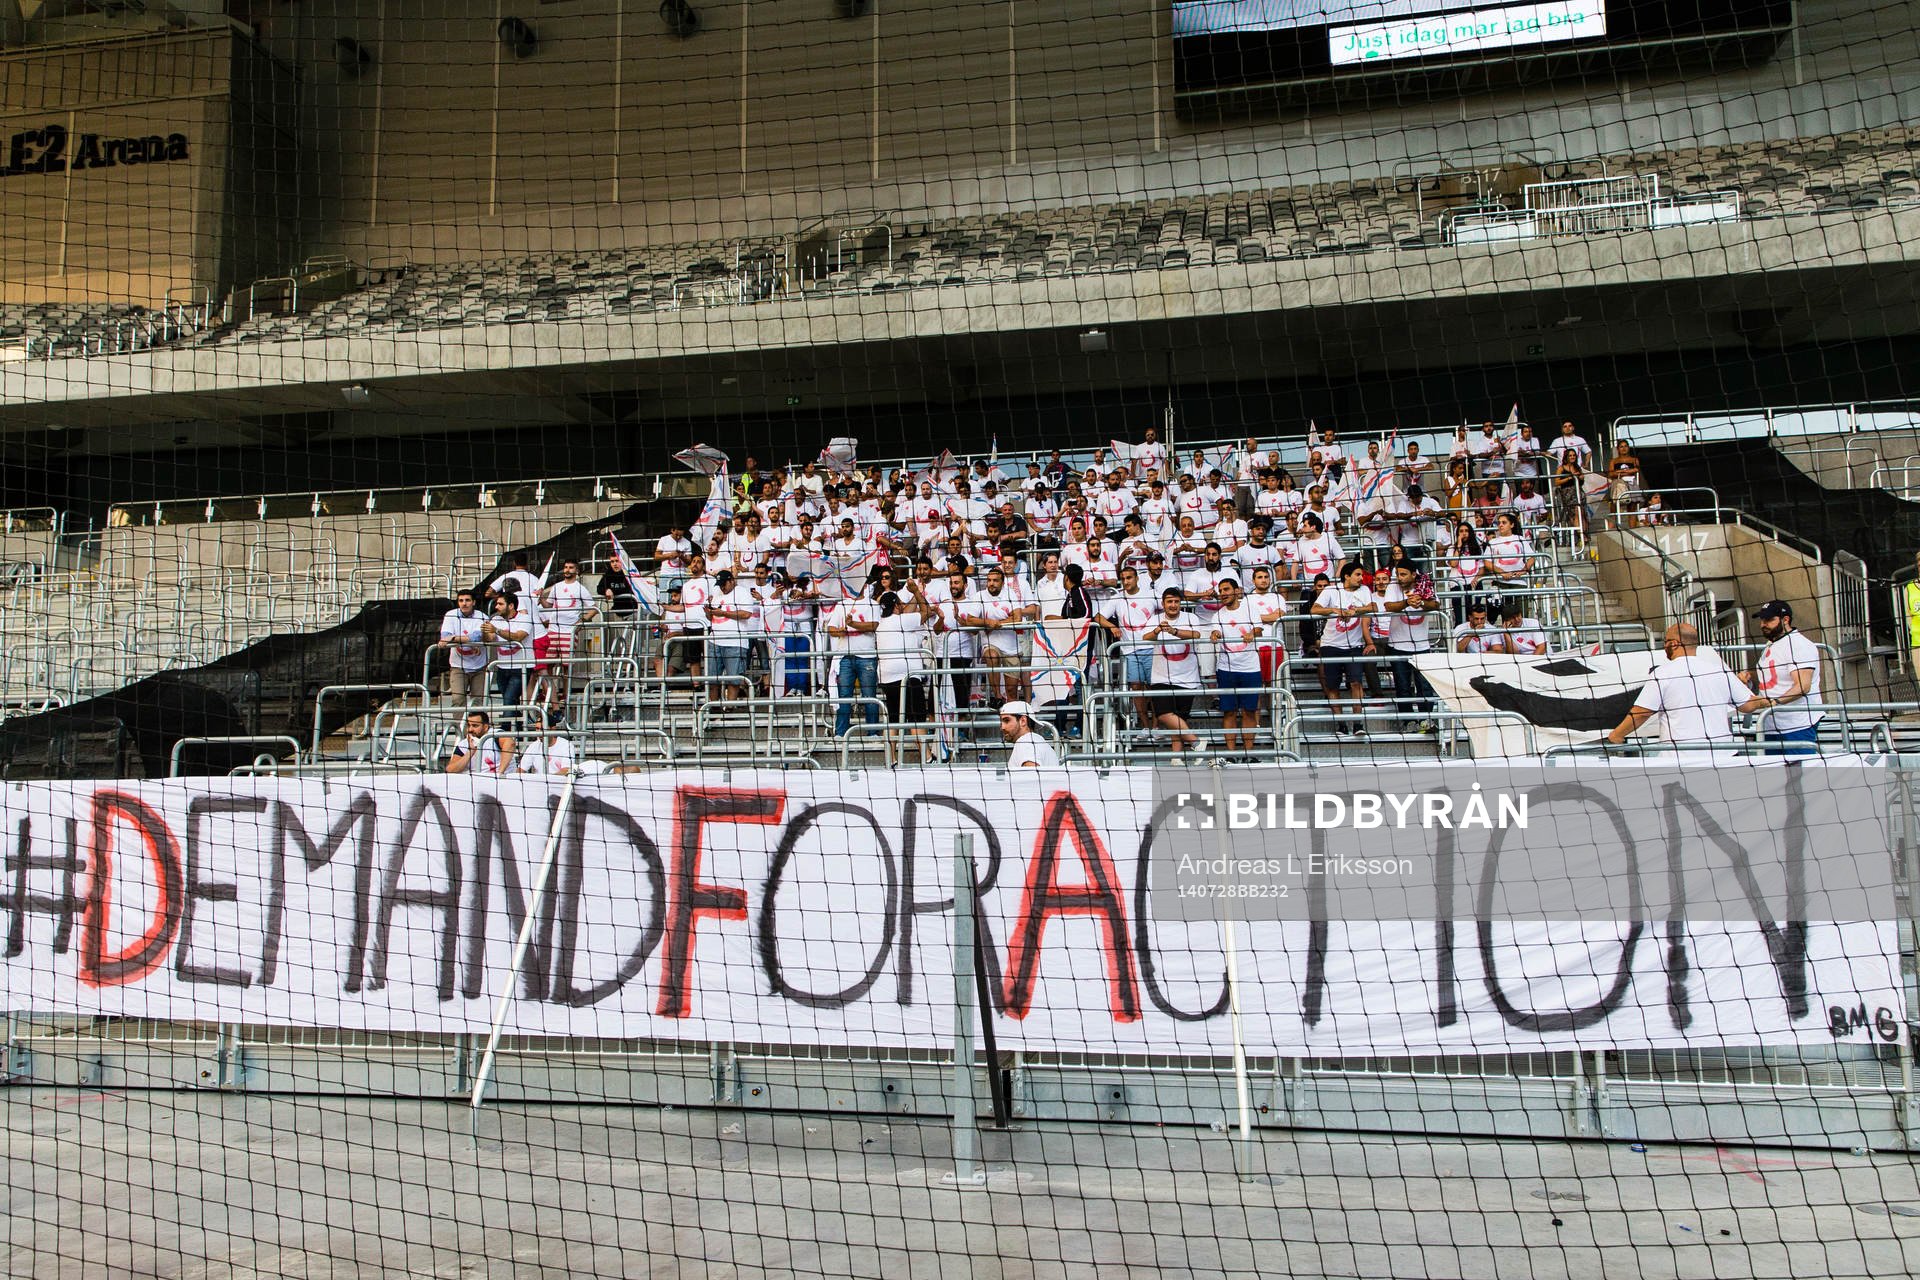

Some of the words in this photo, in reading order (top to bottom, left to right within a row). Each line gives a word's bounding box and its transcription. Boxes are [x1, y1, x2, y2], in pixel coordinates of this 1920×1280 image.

[1344, 33, 1392, 51] Just
[1399, 26, 1447, 45] idag
[1504, 15, 1540, 36] jag
[1547, 11, 1585, 27] bra
[72, 132, 188, 170] Arena
